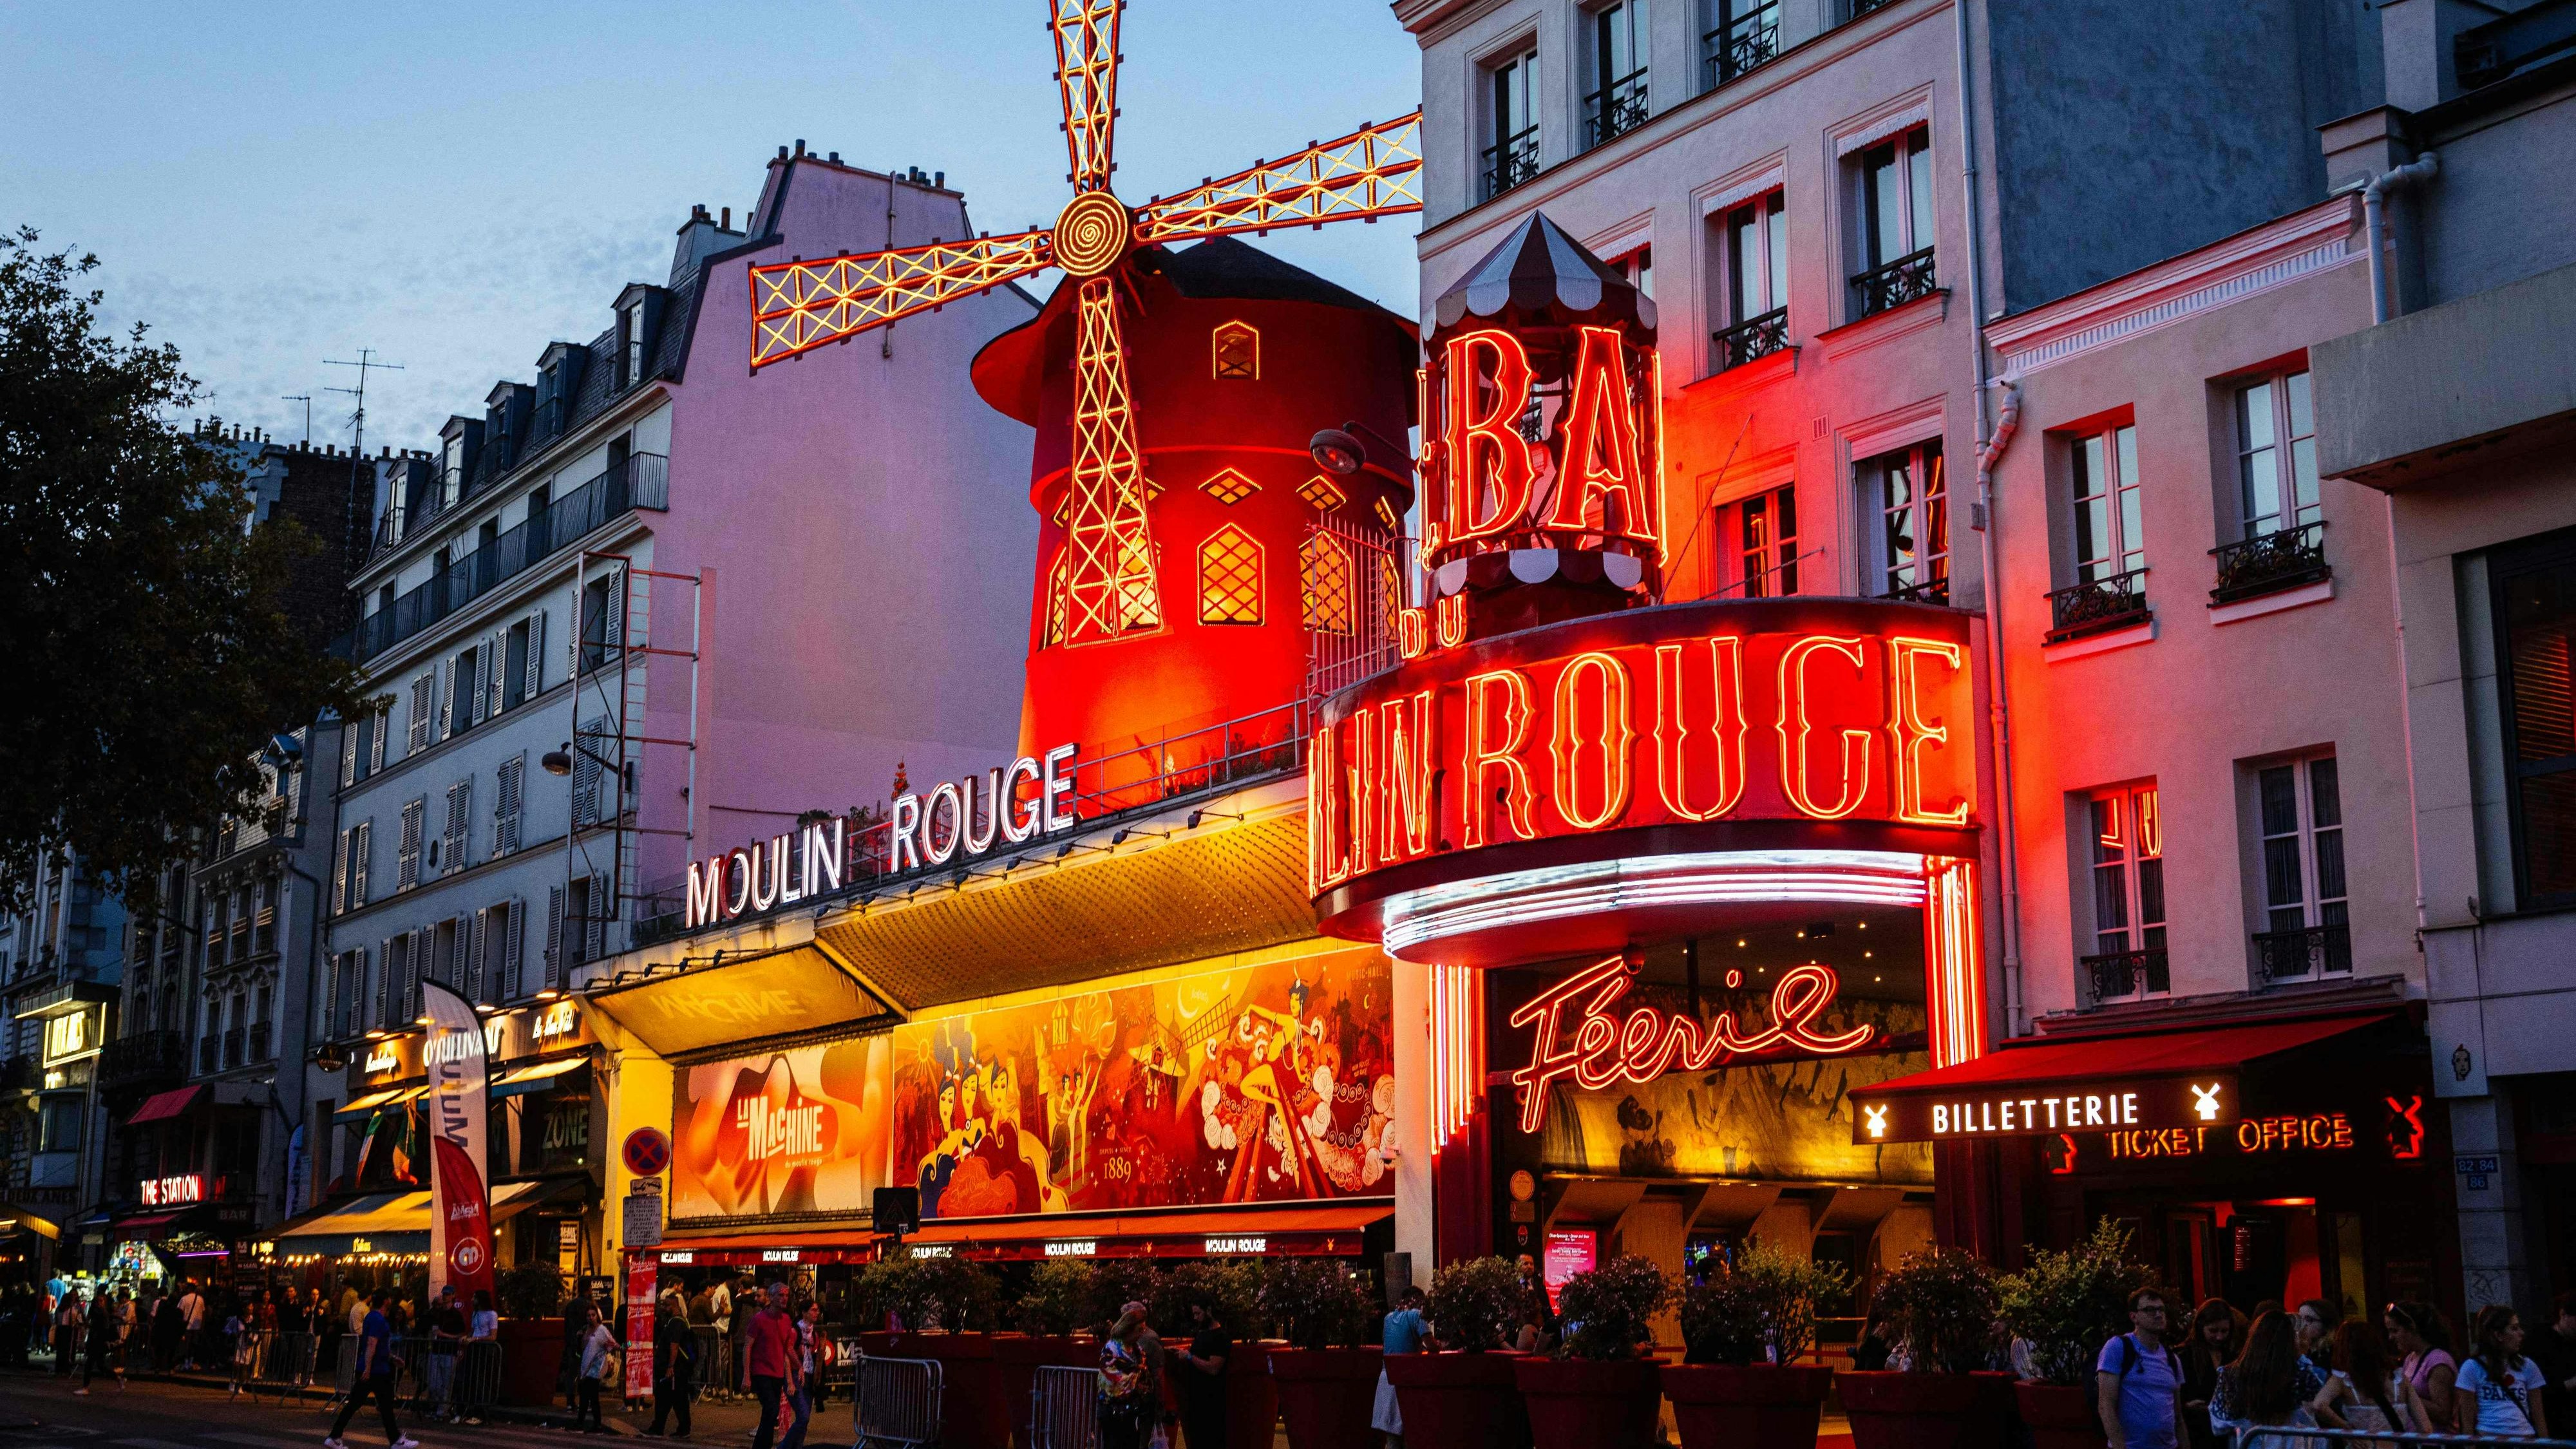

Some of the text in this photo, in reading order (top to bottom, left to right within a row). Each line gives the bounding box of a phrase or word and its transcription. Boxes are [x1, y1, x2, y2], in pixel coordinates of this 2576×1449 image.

[1445, 327, 1669, 568] BA
[1399, 594, 1468, 660] DU
[1309, 635, 1969, 899] LIN ROUGE
[685, 741, 1080, 929] MOULIN ROUGE
[1510, 954, 1875, 1134] Féerie
[737, 1098, 749, 1122] LA
[1933, 1093, 2139, 1133] BILLETTERIE
[2105, 1113, 2354, 1158] TICKET OFFICE
[1103, 1156, 1132, 1184] 1889
[2458, 1160, 2495, 1172] 82 84
[2469, 1176, 2485, 1188] 86
[141, 1179, 158, 1205] THE
[161, 1174, 199, 1205] STATION
[1045, 1242, 1095, 1255] MOULIN ROUGE
[1206, 1238, 1266, 1253] MOULIN ROUGE
